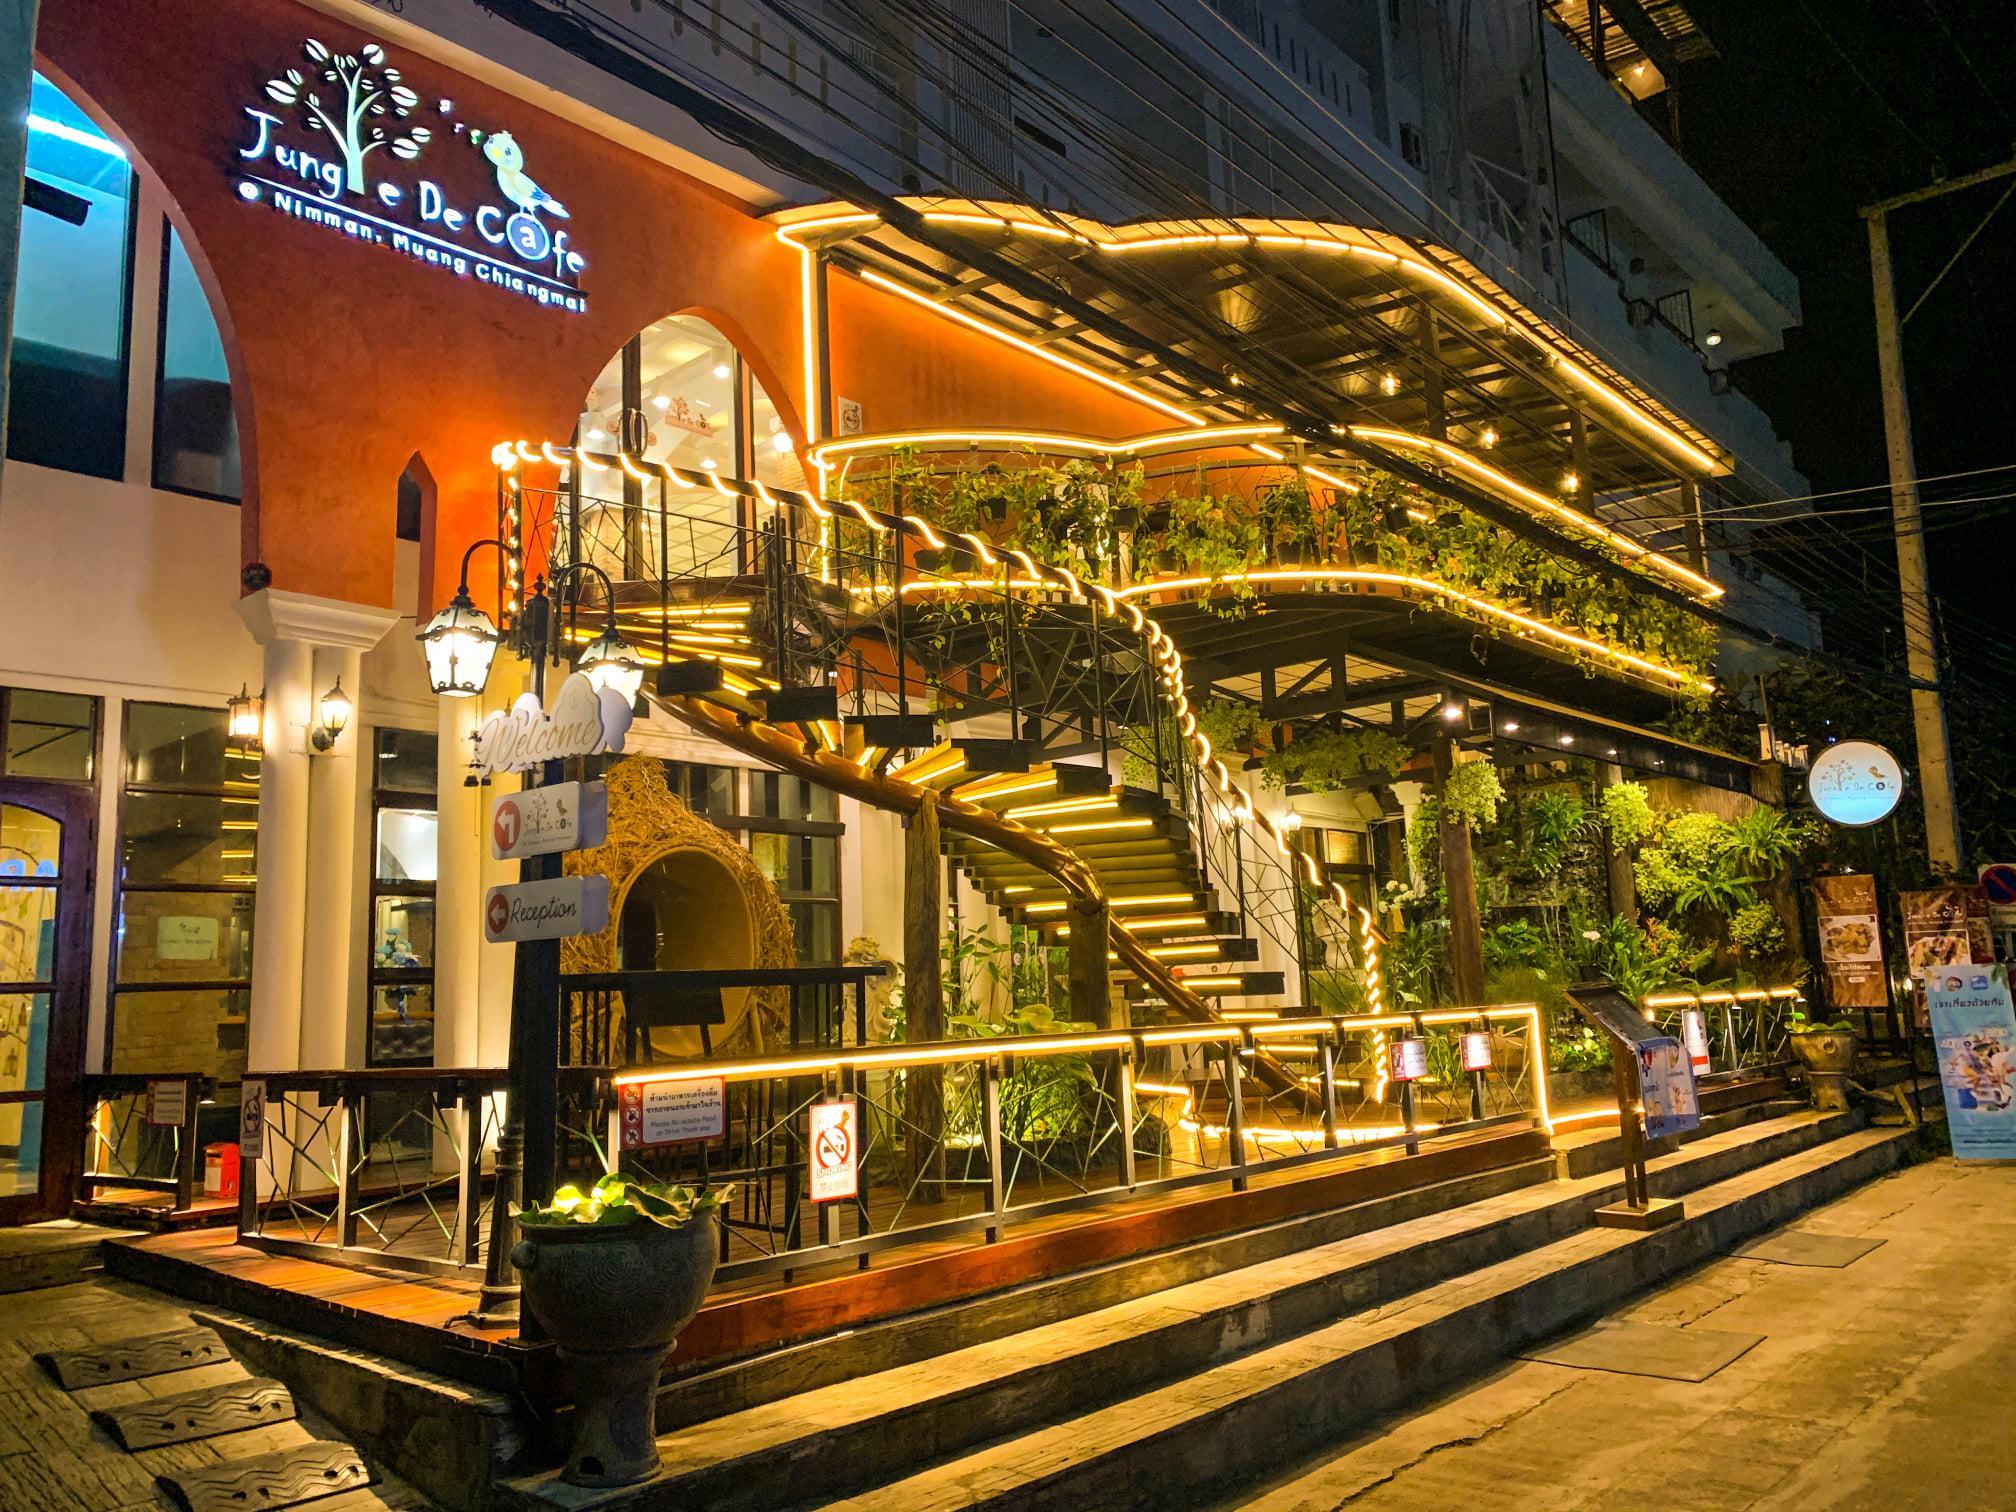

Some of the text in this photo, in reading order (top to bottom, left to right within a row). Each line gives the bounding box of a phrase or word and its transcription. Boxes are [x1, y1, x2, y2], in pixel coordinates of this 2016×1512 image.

[274, 192, 383, 244] Nimman,
[393, 232, 467, 276] Muang
[475, 262, 587, 314] Chiangmai
[418, 180, 465, 231] De
[475, 203, 586, 278] Cafe
[480, 715, 597, 765] Welcome
[510, 898, 577, 928] Reception
[816, 1161, 853, 1178] SMOKING
